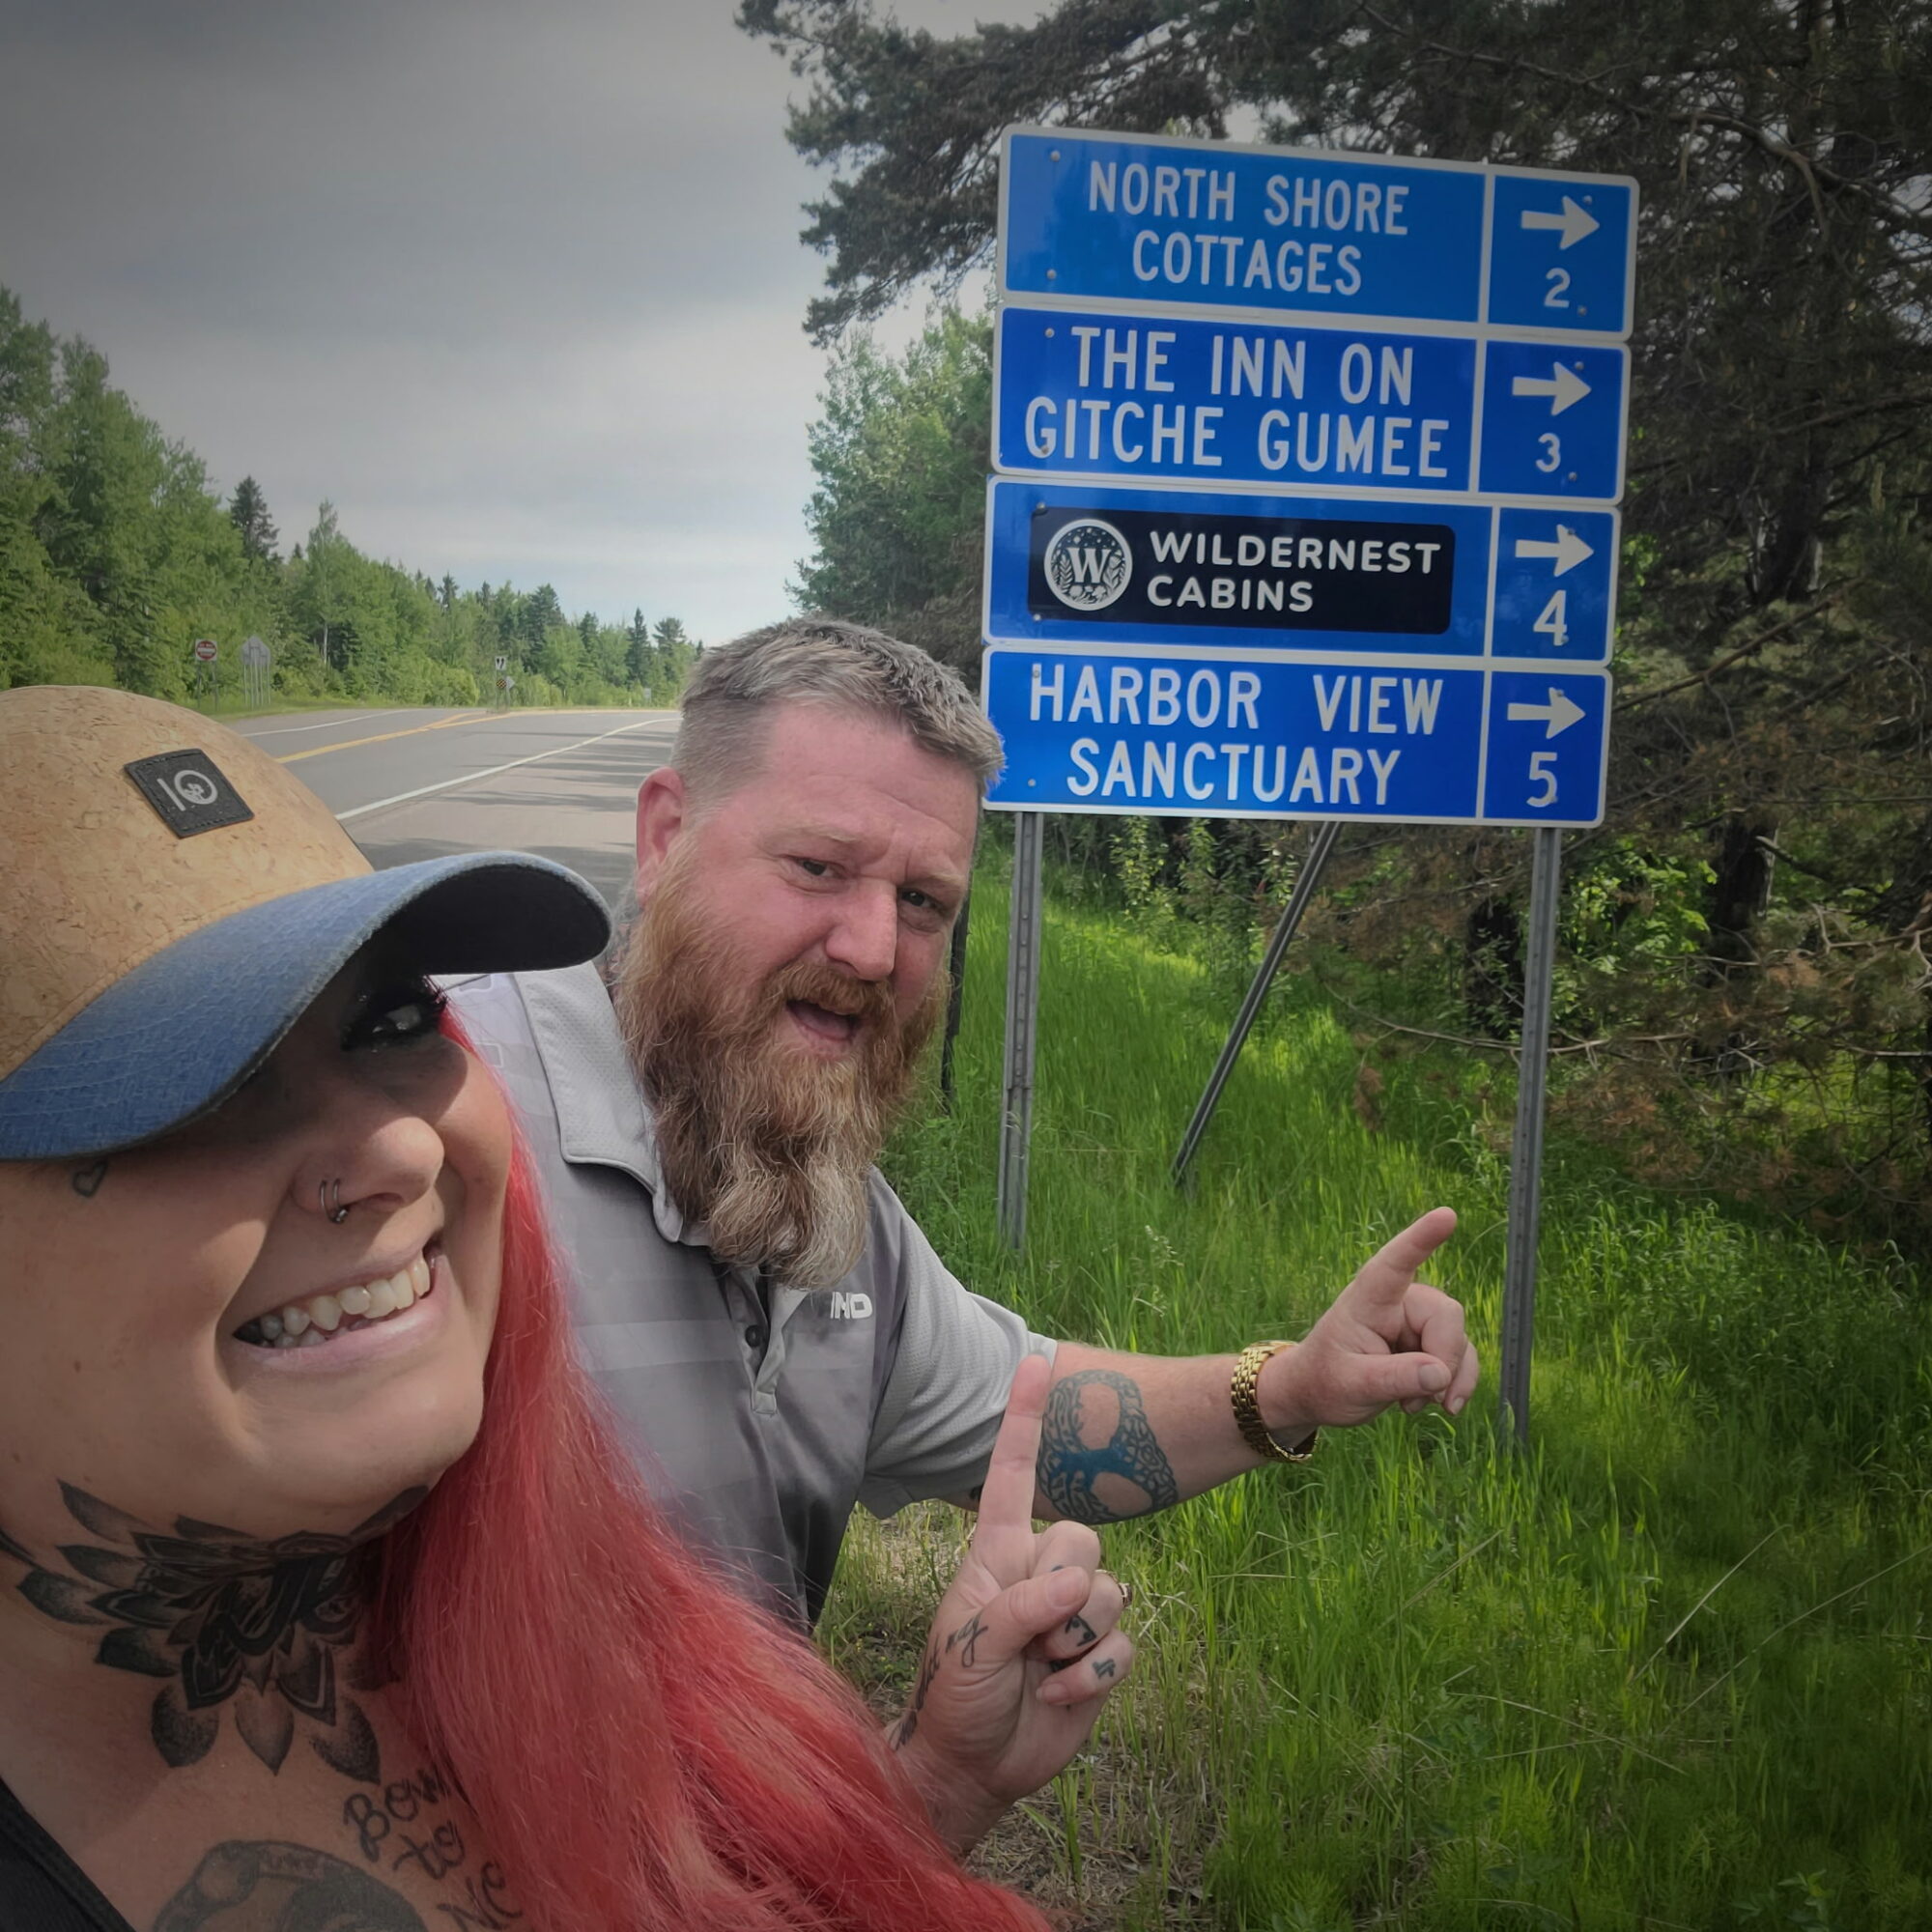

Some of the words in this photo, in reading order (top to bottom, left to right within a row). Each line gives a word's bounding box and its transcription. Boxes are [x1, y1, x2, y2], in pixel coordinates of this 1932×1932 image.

[1089, 159, 1236, 222] NORTH
[1264, 174, 1409, 236] SHORE
[1132, 231, 1362, 296] COTTAGES
[1544, 268, 1571, 308] 2
[1070, 326, 1177, 392] THE
[1210, 334, 1306, 400] INN
[1339, 343, 1413, 406] ON
[1025, 396, 1224, 467] GITCHE
[1258, 410, 1449, 478] GUMEE
[1535, 432, 1561, 473] 3
[1065, 547, 1112, 583] W
[1150, 530, 1441, 574] WILDERNEST
[1147, 576, 1314, 612] CABINS
[1533, 589, 1568, 646] 4
[1030, 664, 1262, 729] HARBOR
[1313, 674, 1443, 735] VIEW
[1066, 738, 1401, 806] SANCTUARY
[1526, 751, 1558, 808] 5
